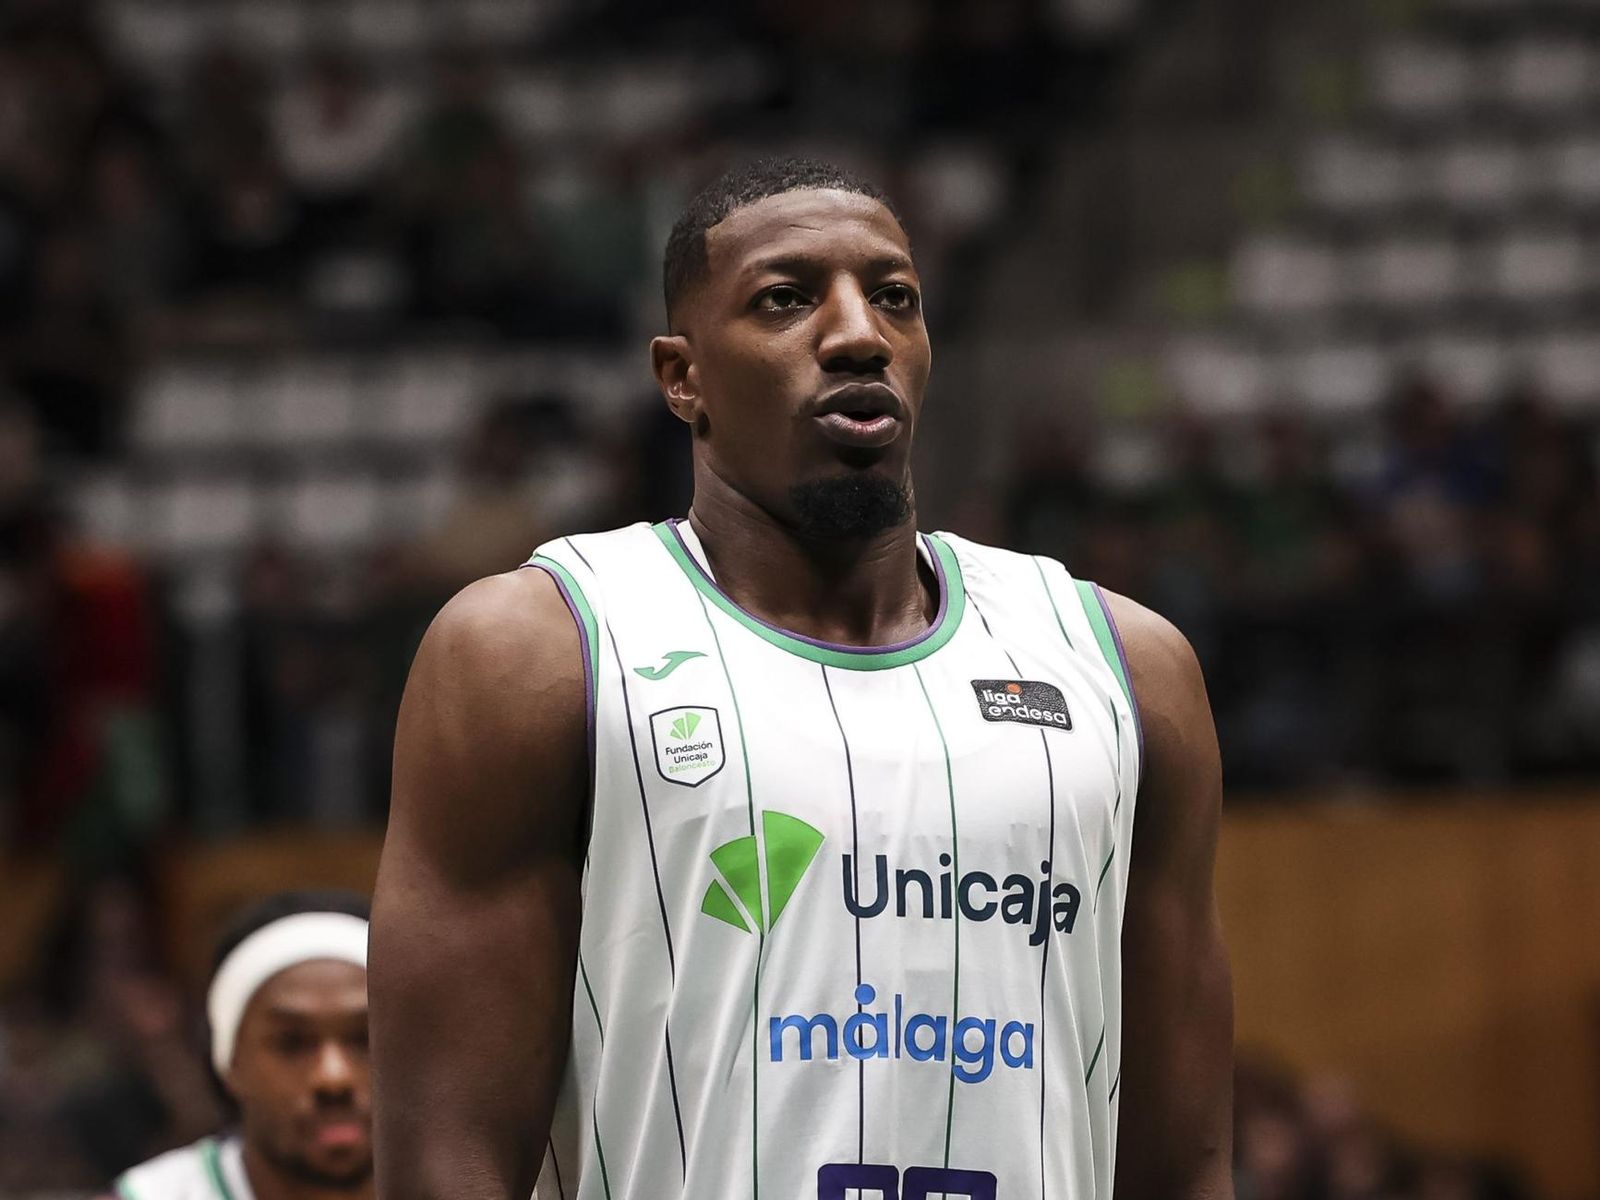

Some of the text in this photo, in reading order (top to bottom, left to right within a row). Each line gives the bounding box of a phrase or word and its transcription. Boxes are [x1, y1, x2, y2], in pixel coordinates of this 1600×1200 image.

[981, 688, 1021, 705] liga
[988, 704, 1067, 725] endesa
[665, 740, 713, 755] Fundación
[674, 752, 708, 764] Unicaja
[841, 852, 1081, 947] Unicaja
